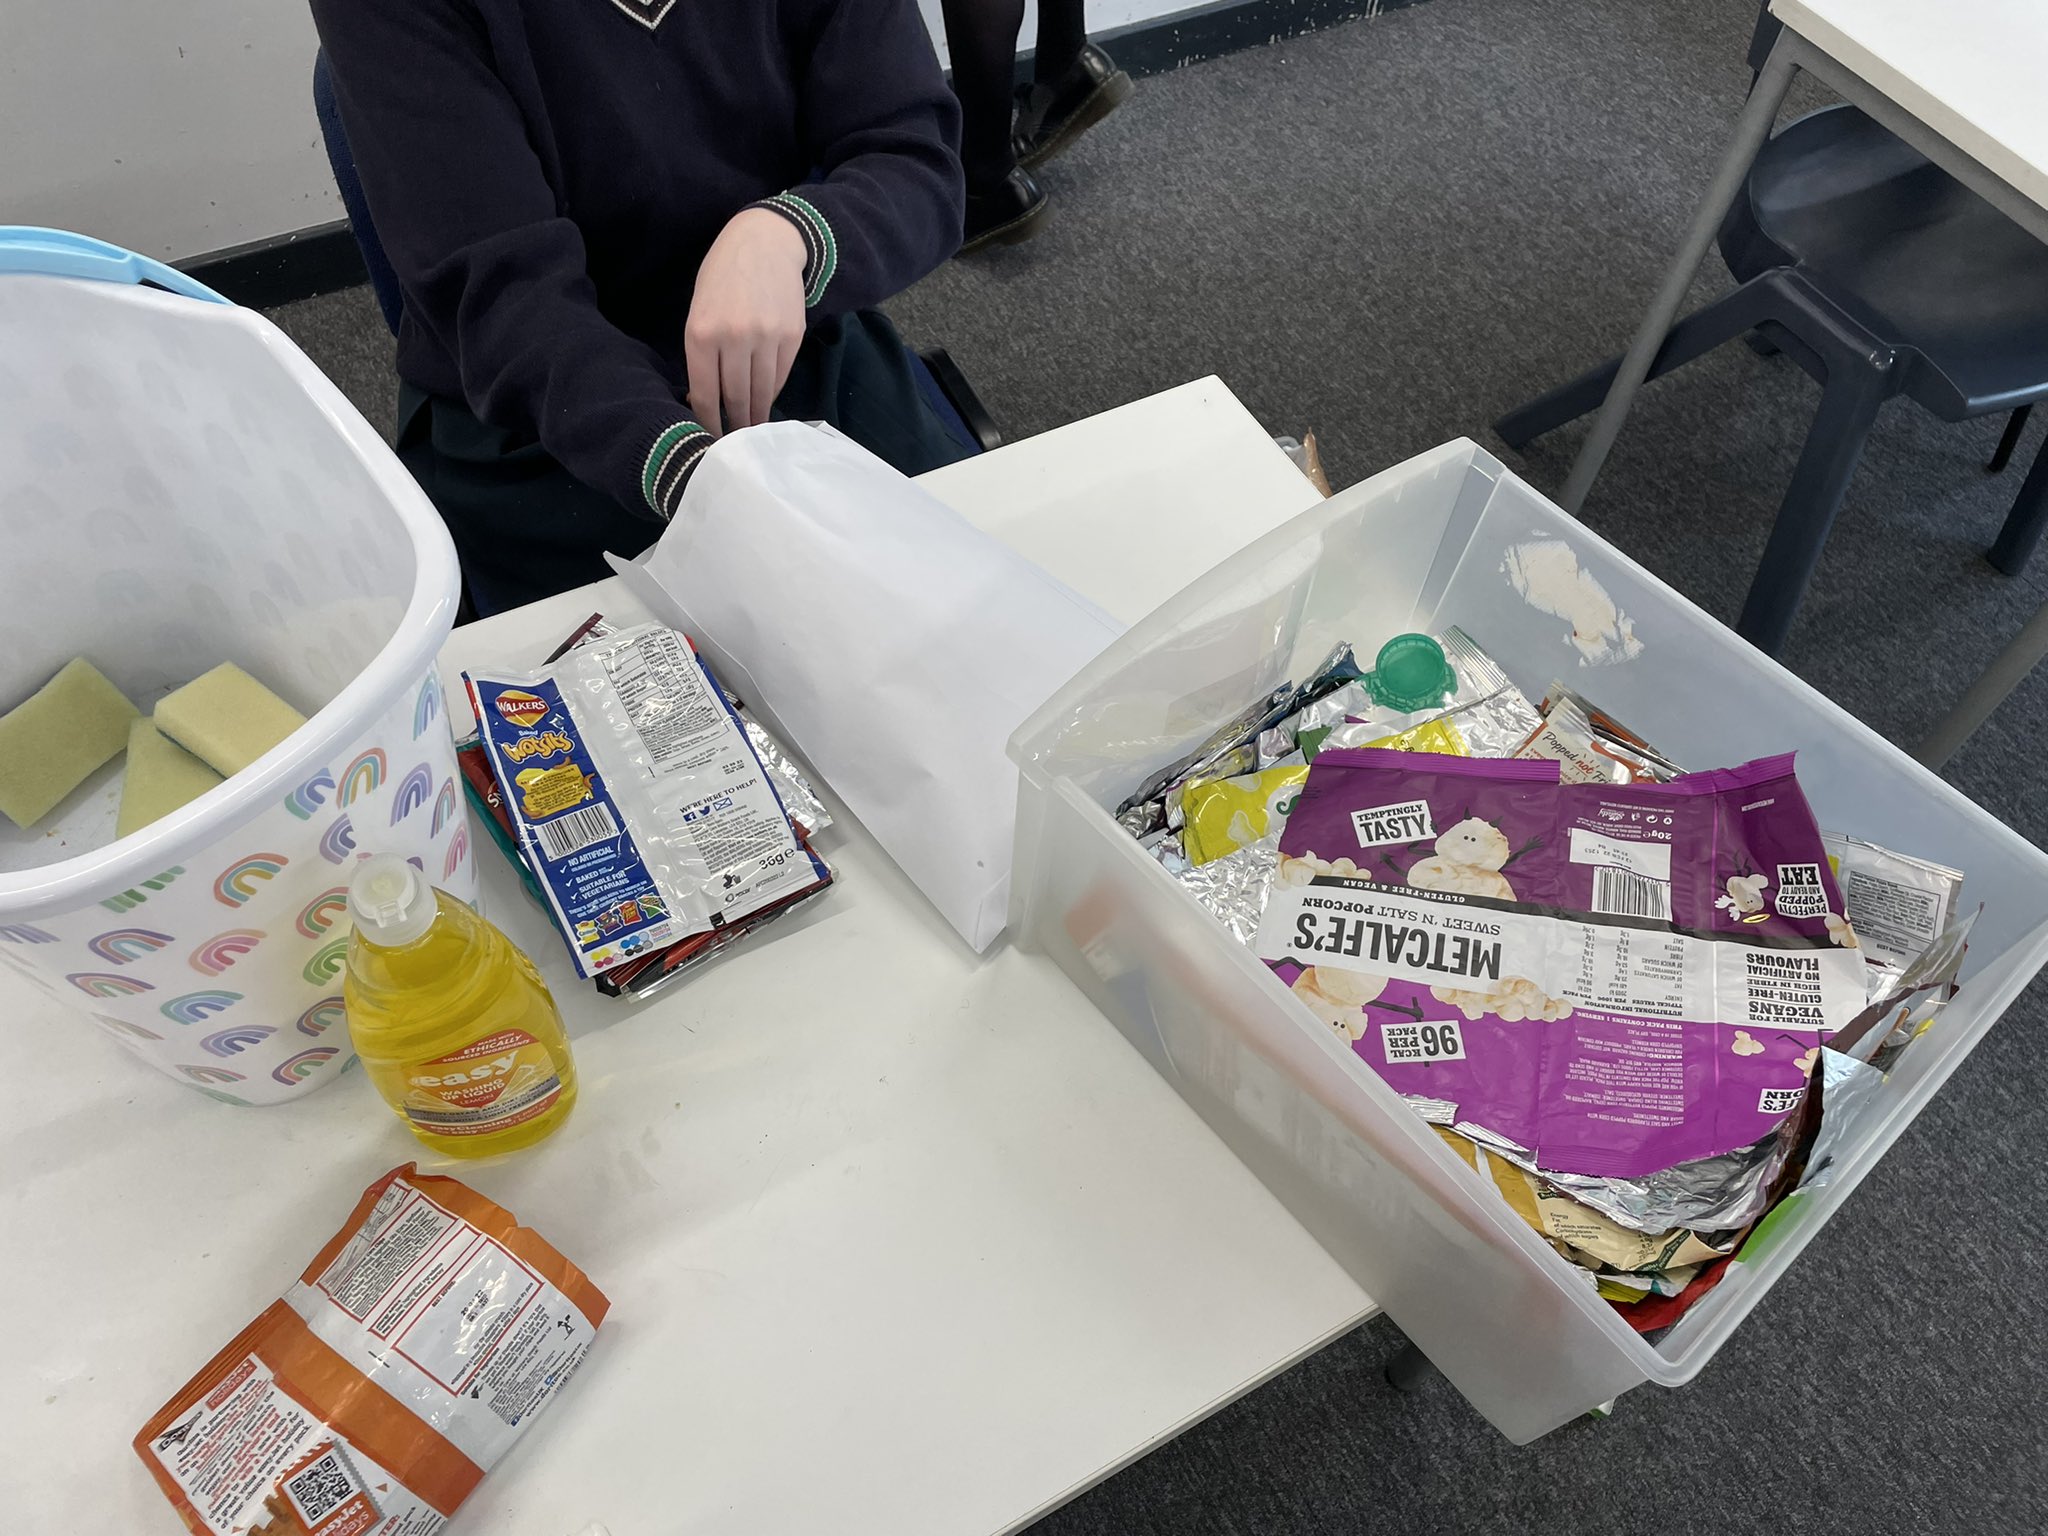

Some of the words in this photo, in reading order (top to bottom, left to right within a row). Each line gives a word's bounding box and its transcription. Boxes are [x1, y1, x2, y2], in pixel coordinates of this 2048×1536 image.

[496, 701, 546, 713] WALKERS
[1542, 731, 1578, 761] Popped
[1575, 760, 1593, 773] not
[703, 792, 721, 803] HERE
[735, 778, 756, 790] HELP!
[1356, 804, 1425, 823] TEMPTINGLY
[1359, 813, 1426, 844] TASTY
[568, 857, 578, 866] NO
[579, 846, 613, 861] ARTIFICIAL
[575, 870, 598, 883] BAKED
[579, 876, 611, 892] SUITABLE
[611, 870, 626, 879] FOR
[1781, 866, 1818, 885] EAT
[581, 878, 629, 898] VEGETARIANS
[1343, 879, 1376, 889] VEGAN
[1392, 886, 1464, 902] GLUTEN-FREE
[1779, 895, 1824, 904] POPPED
[1302, 897, 1373, 914] POPCORN
[1377, 906, 1417, 921] SALT
[1779, 903, 1826, 915] PERFECTLY
[1442, 917, 1500, 935] SWEET
[1295, 914, 1499, 977] METCALFE'S
[1746, 953, 1818, 970] FLAVOURS
[1747, 965, 1801, 978] ARTIFICIAL
[1804, 972, 1819, 980] NO
[1748, 988, 1821, 1002] GLUTEN-FREE
[1584, 1000, 1632, 1011] INFORMATION
[1634, 1007, 1682, 1016] NUTRITIONAL
[1749, 1001, 1822, 1017] VEGANS
[1612, 1017, 1644, 1025] CONTAINS
[1773, 1016, 1823, 1024] SUITABLE
[1386, 1027, 1418, 1036] PACK
[464, 1034, 522, 1054] ETHICALLY
[1388, 1037, 1420, 1048] PER
[1421, 1025, 1459, 1056] 96
[443, 1053, 480, 1062] SOURCED
[1391, 1049, 1421, 1058] KCAL
[410, 1050, 520, 1086] easy
[441, 1079, 503, 1097] WASHING
[463, 1082, 505, 1098] LIQUID
[460, 1094, 493, 1104] LEMON
